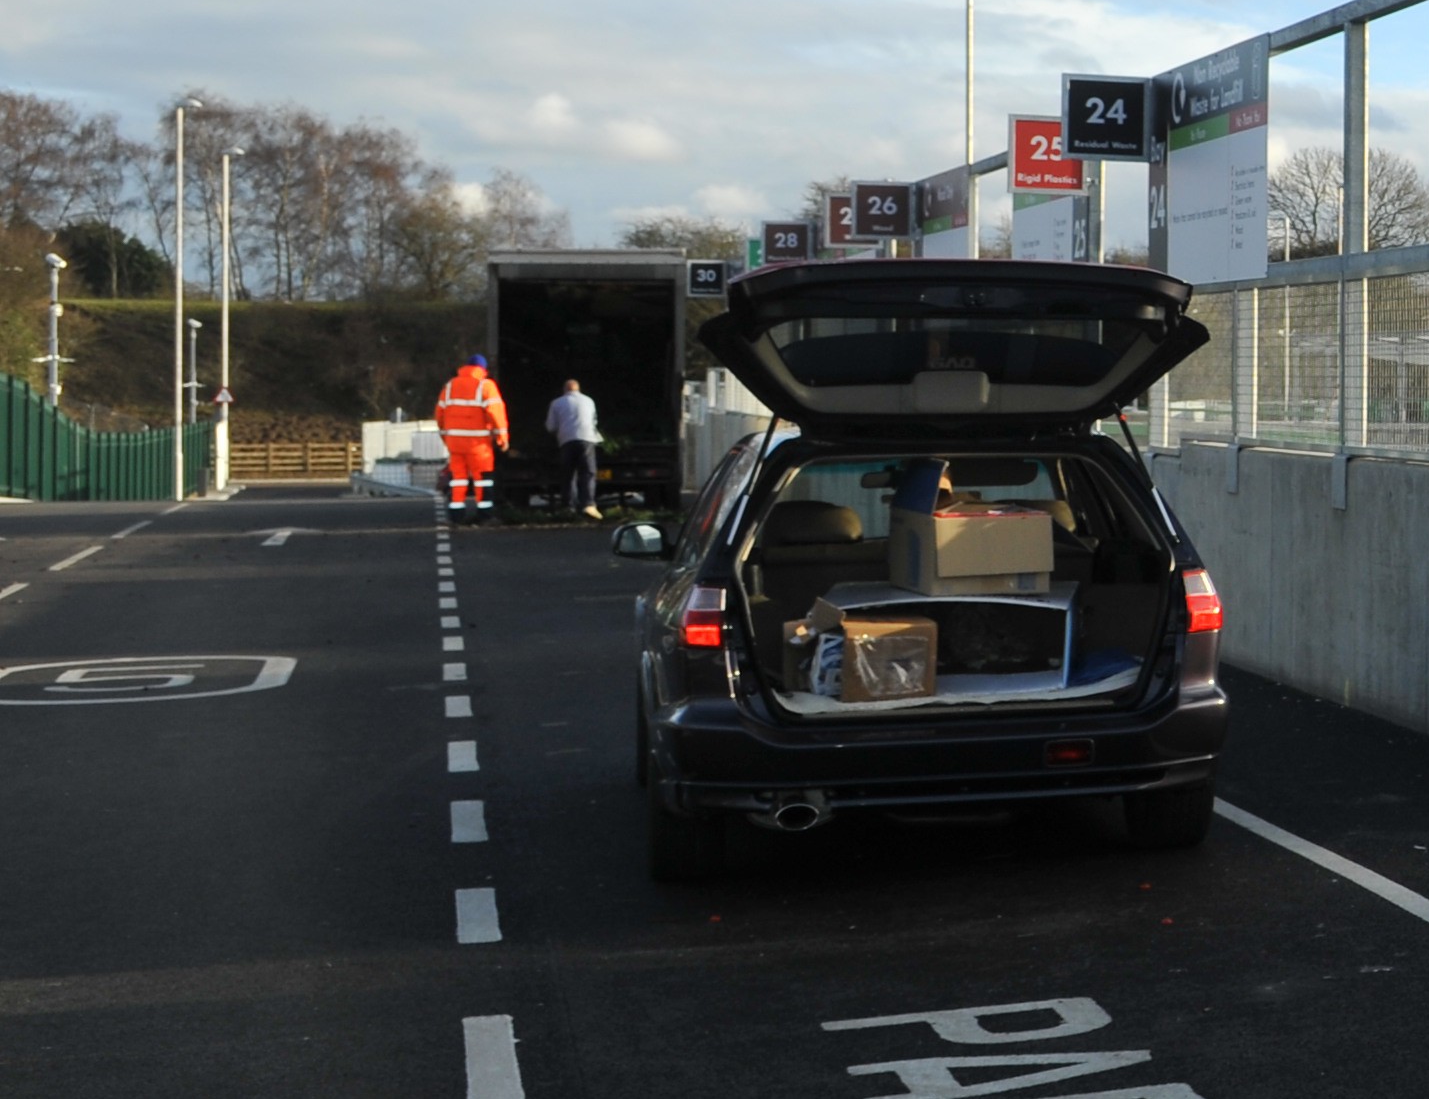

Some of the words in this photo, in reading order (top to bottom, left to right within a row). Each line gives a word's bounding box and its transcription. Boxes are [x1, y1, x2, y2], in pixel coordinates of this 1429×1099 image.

[1085, 97, 1127, 125] 24
[1030, 135, 1062, 162] 25
[1074, 139, 1109, 150] Residual
[1111, 141, 1138, 151] Waste
[1017, 172, 1041, 185] Rigid
[1044, 173, 1077, 185] Plastics
[839, 206, 852, 226] 2
[867, 196, 898, 216] 26
[1150, 184, 1165, 230] 24
[774, 232, 798, 248] 28
[1074, 218, 1086, 259] 25
[696, 269, 716, 282] 30
[44, 663, 205, 692] 5
[820, 997, 1206, 1099] PA
